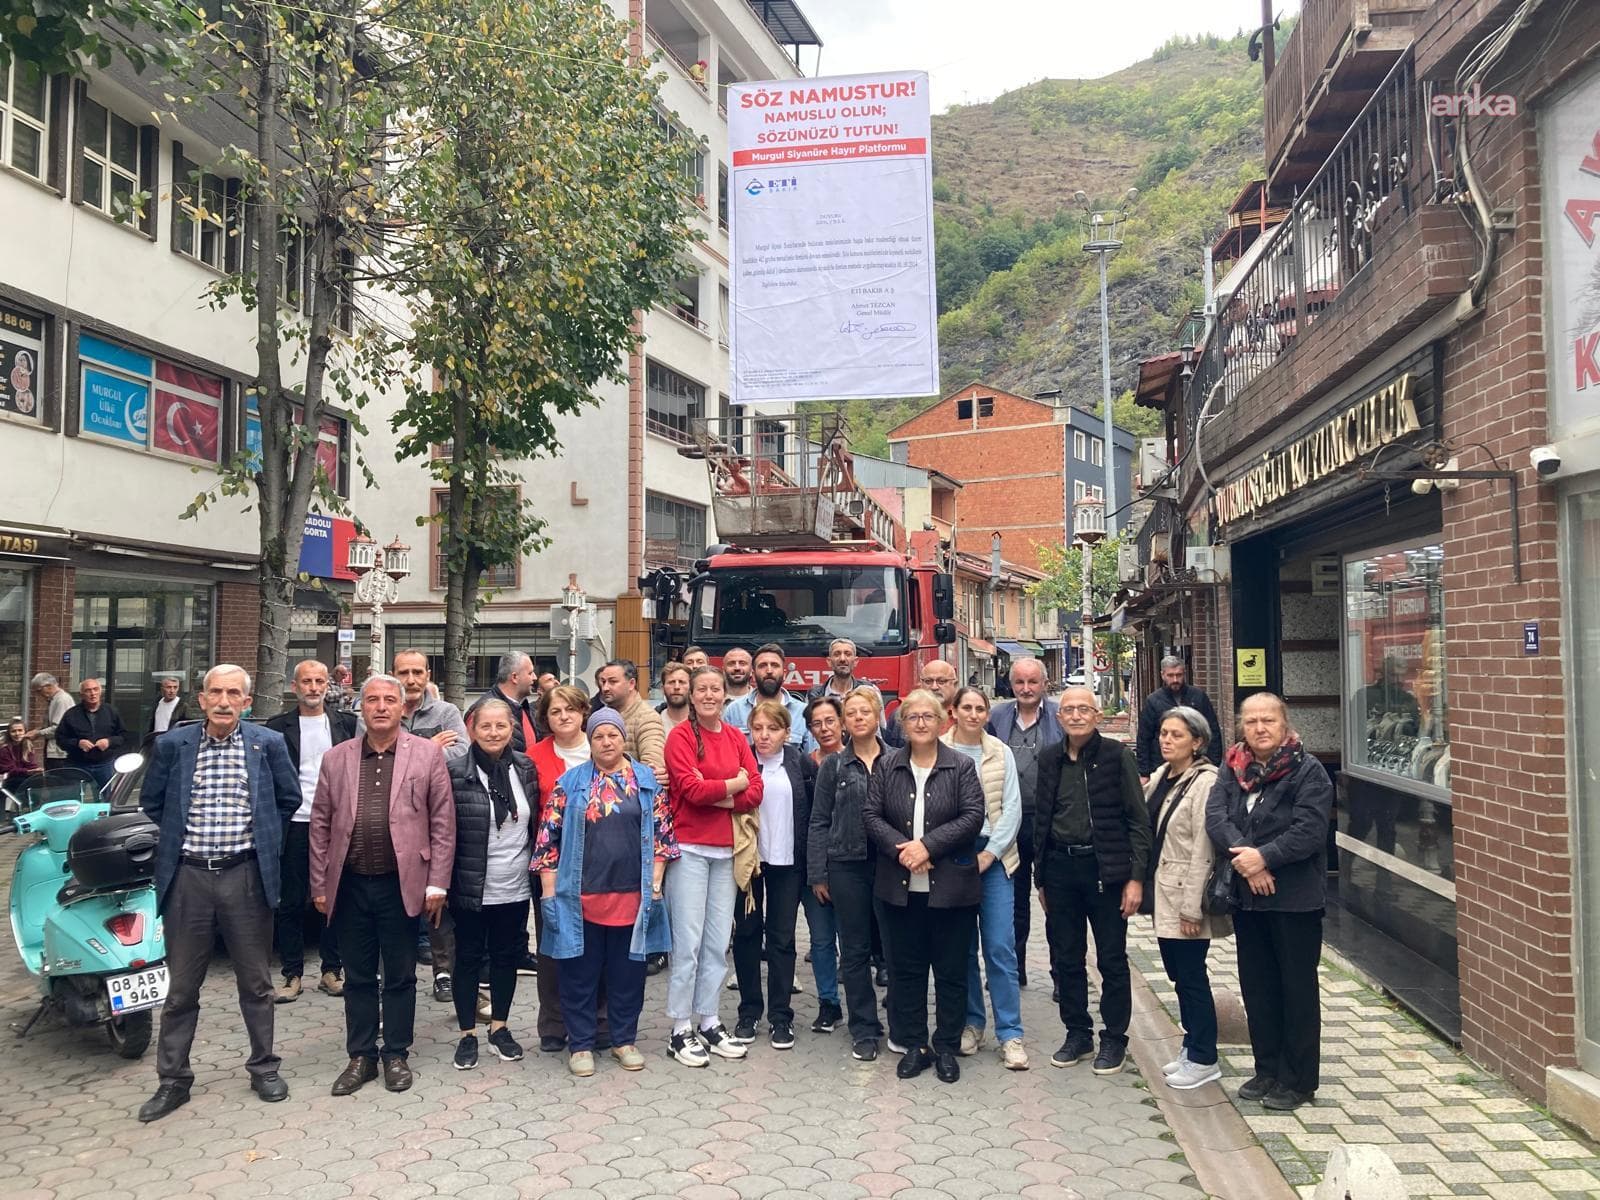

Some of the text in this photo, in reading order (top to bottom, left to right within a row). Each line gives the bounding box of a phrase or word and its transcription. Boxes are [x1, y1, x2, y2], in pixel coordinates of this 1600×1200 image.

[741, 81, 916, 109] SÖZ NAMUSTUR!
[764, 105, 886, 124] NAMUSLU OLUN;
[758, 123, 898, 144] SÖZÜNÜZÜ TUTUN!
[752, 142, 907, 162] Murgul Siyanüre Hayır Platformu
[19, 318, 32, 331] 08
[92, 383, 123, 402] MURGUL
[1290, 372, 1421, 487] KUYUMCULUK
[304, 527, 328, 538] GORTA
[112, 969, 167, 993] 08 ABV
[130, 987, 159, 1003] 946
